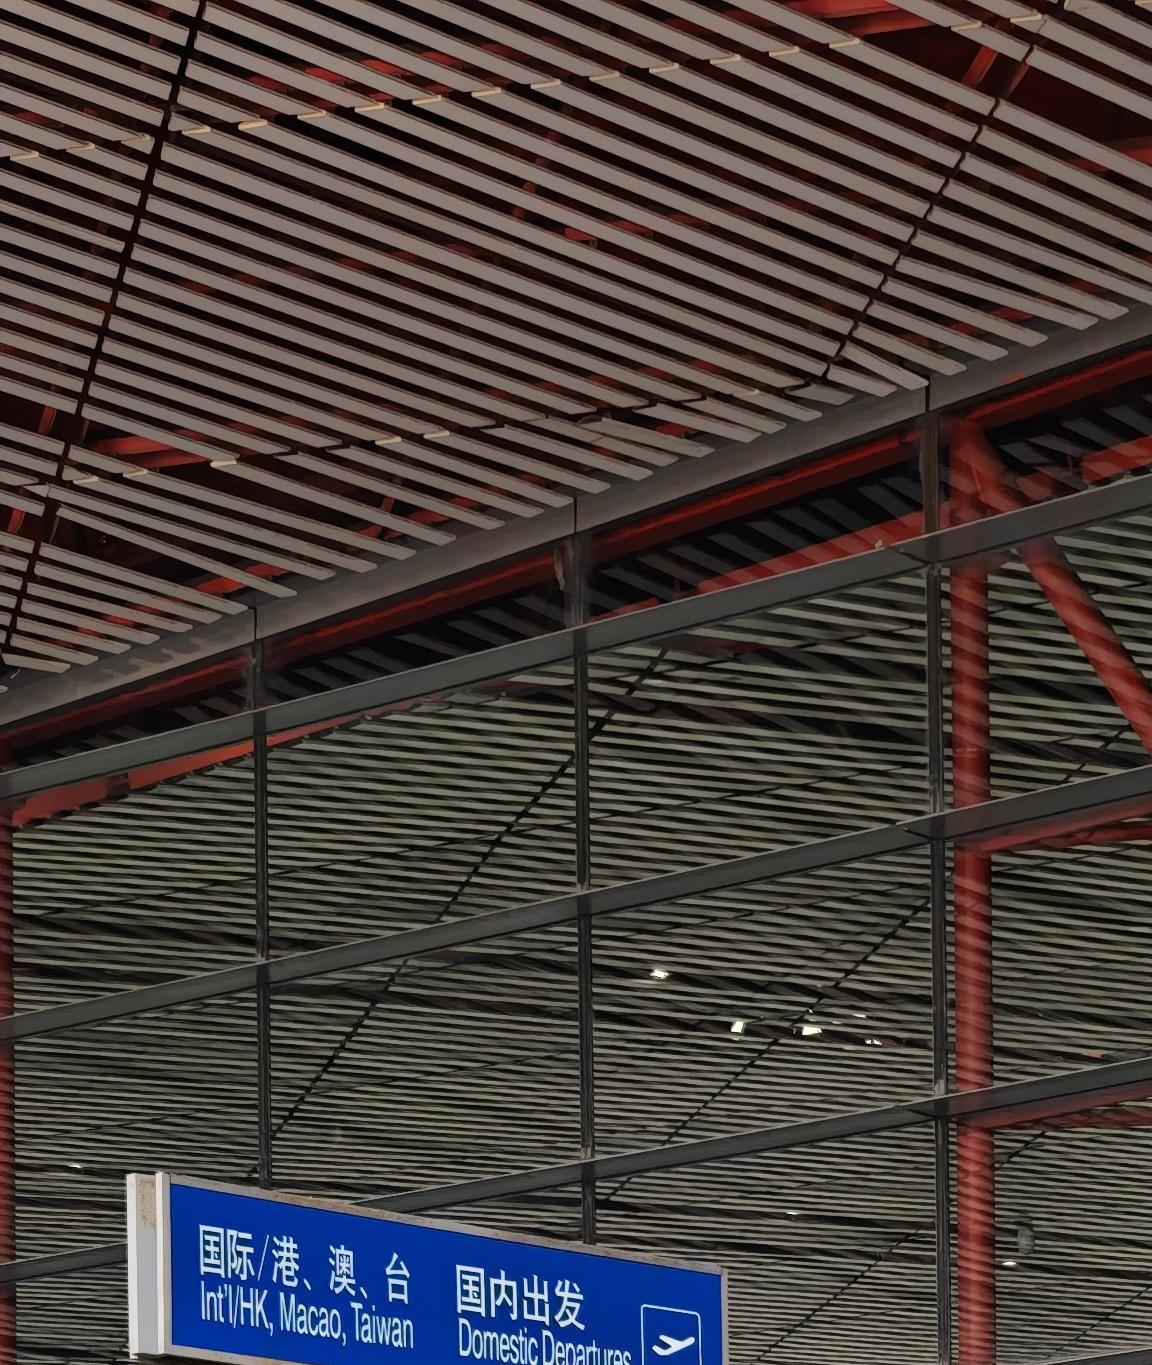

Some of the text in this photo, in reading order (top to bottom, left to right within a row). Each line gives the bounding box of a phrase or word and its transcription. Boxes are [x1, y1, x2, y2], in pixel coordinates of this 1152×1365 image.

[279, 1291, 347, 1346] Macao,
[350, 1302, 413, 1348] Taiwan
[456, 1264, 585, 1331] 国内出发
